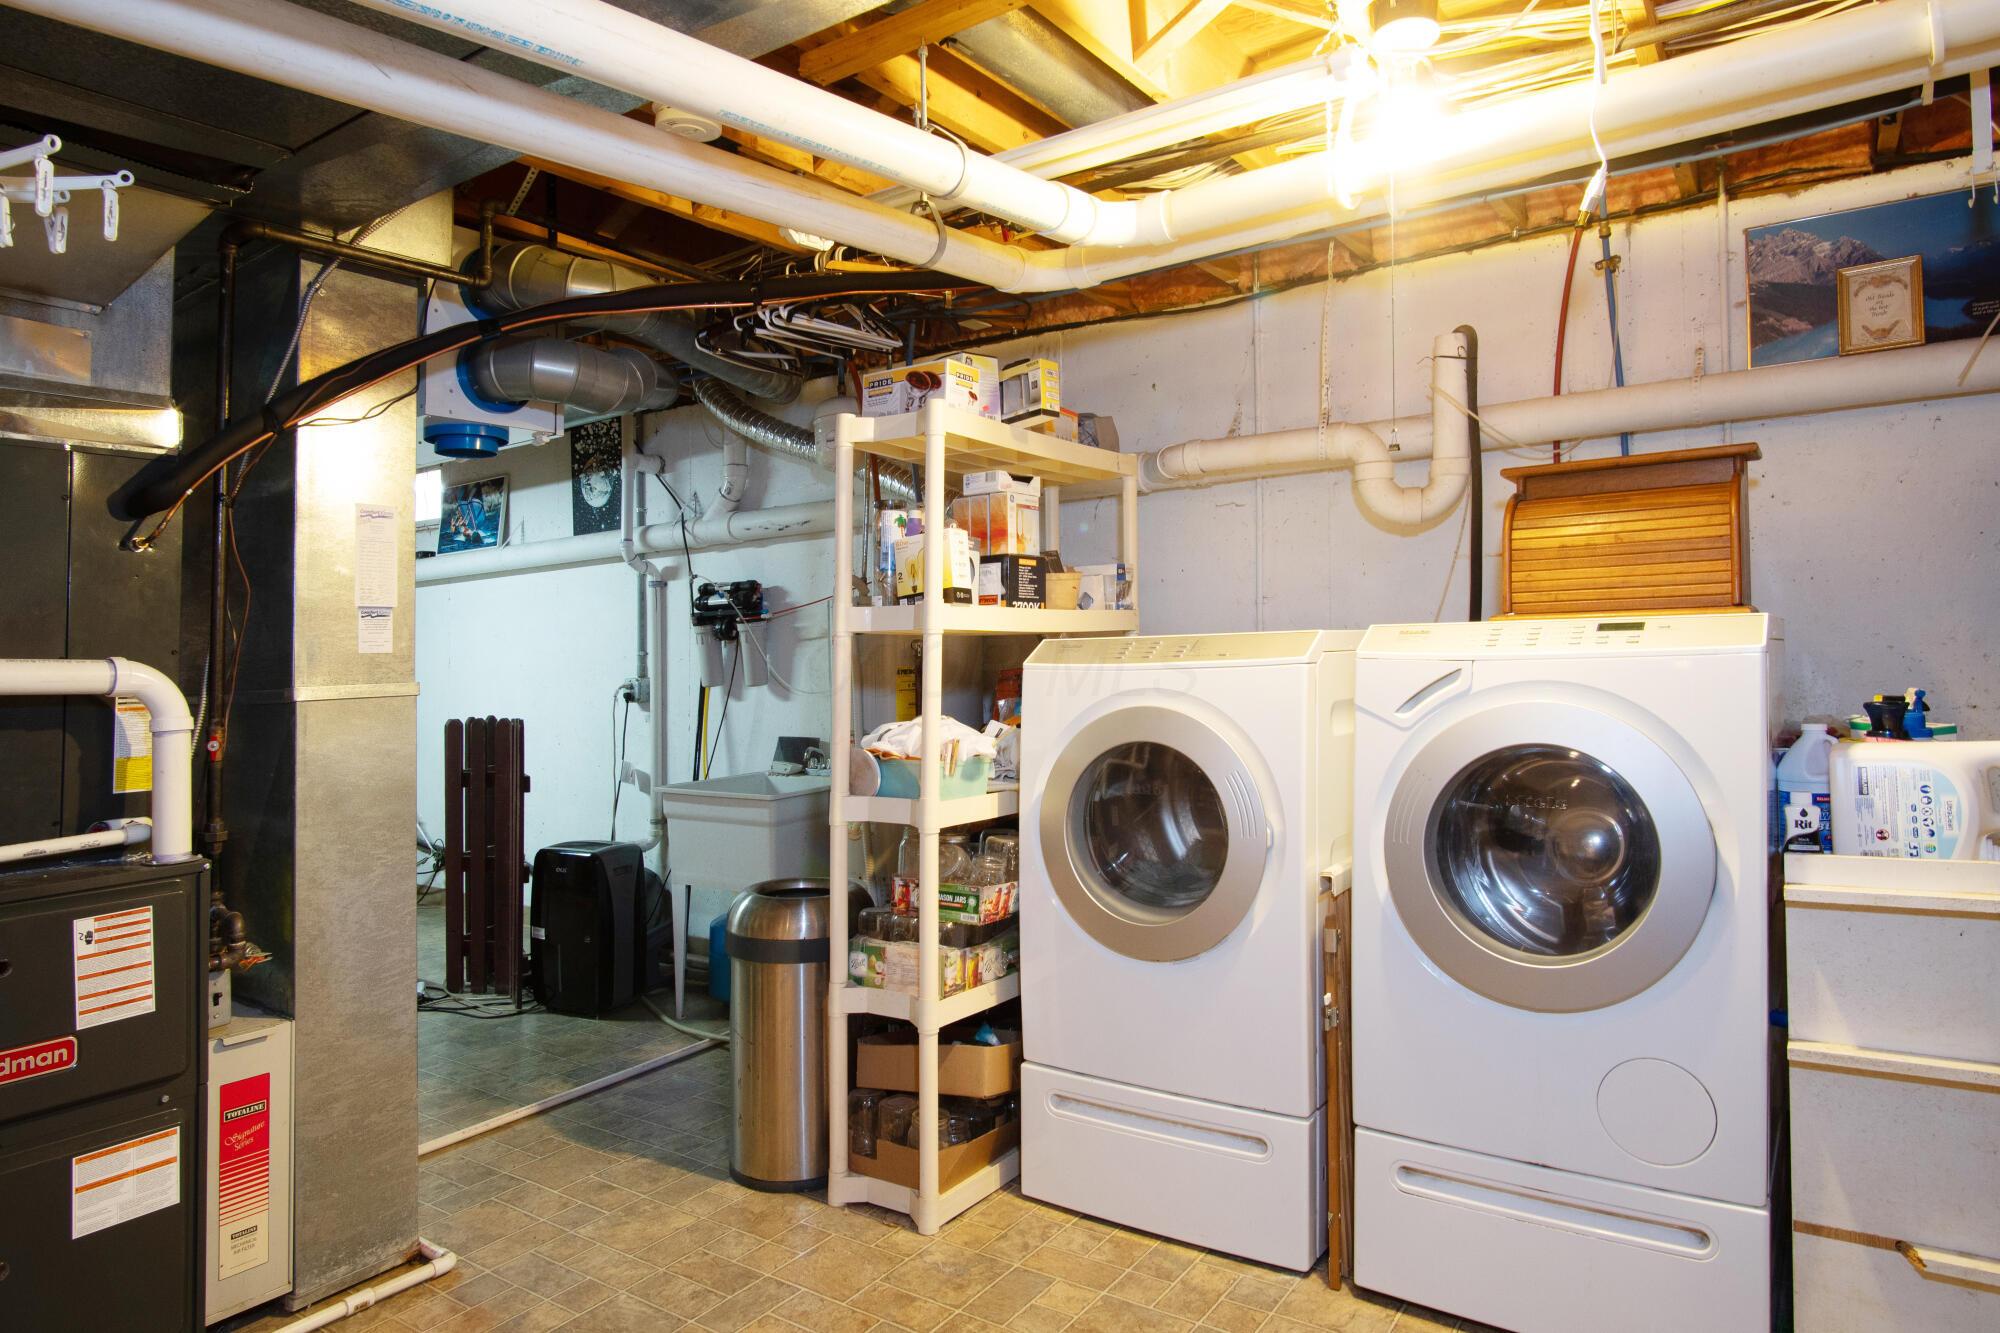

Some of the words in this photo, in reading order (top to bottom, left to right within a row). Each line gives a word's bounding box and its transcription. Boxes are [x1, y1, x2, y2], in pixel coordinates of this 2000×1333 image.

[869, 378, 893, 389] PRIDE
[1794, 820, 1812, 830] Rit
[226, 1102, 265, 1120] TOTALINE
[225, 1120, 265, 1146] Signature
[234, 1136, 254, 1152] Series
